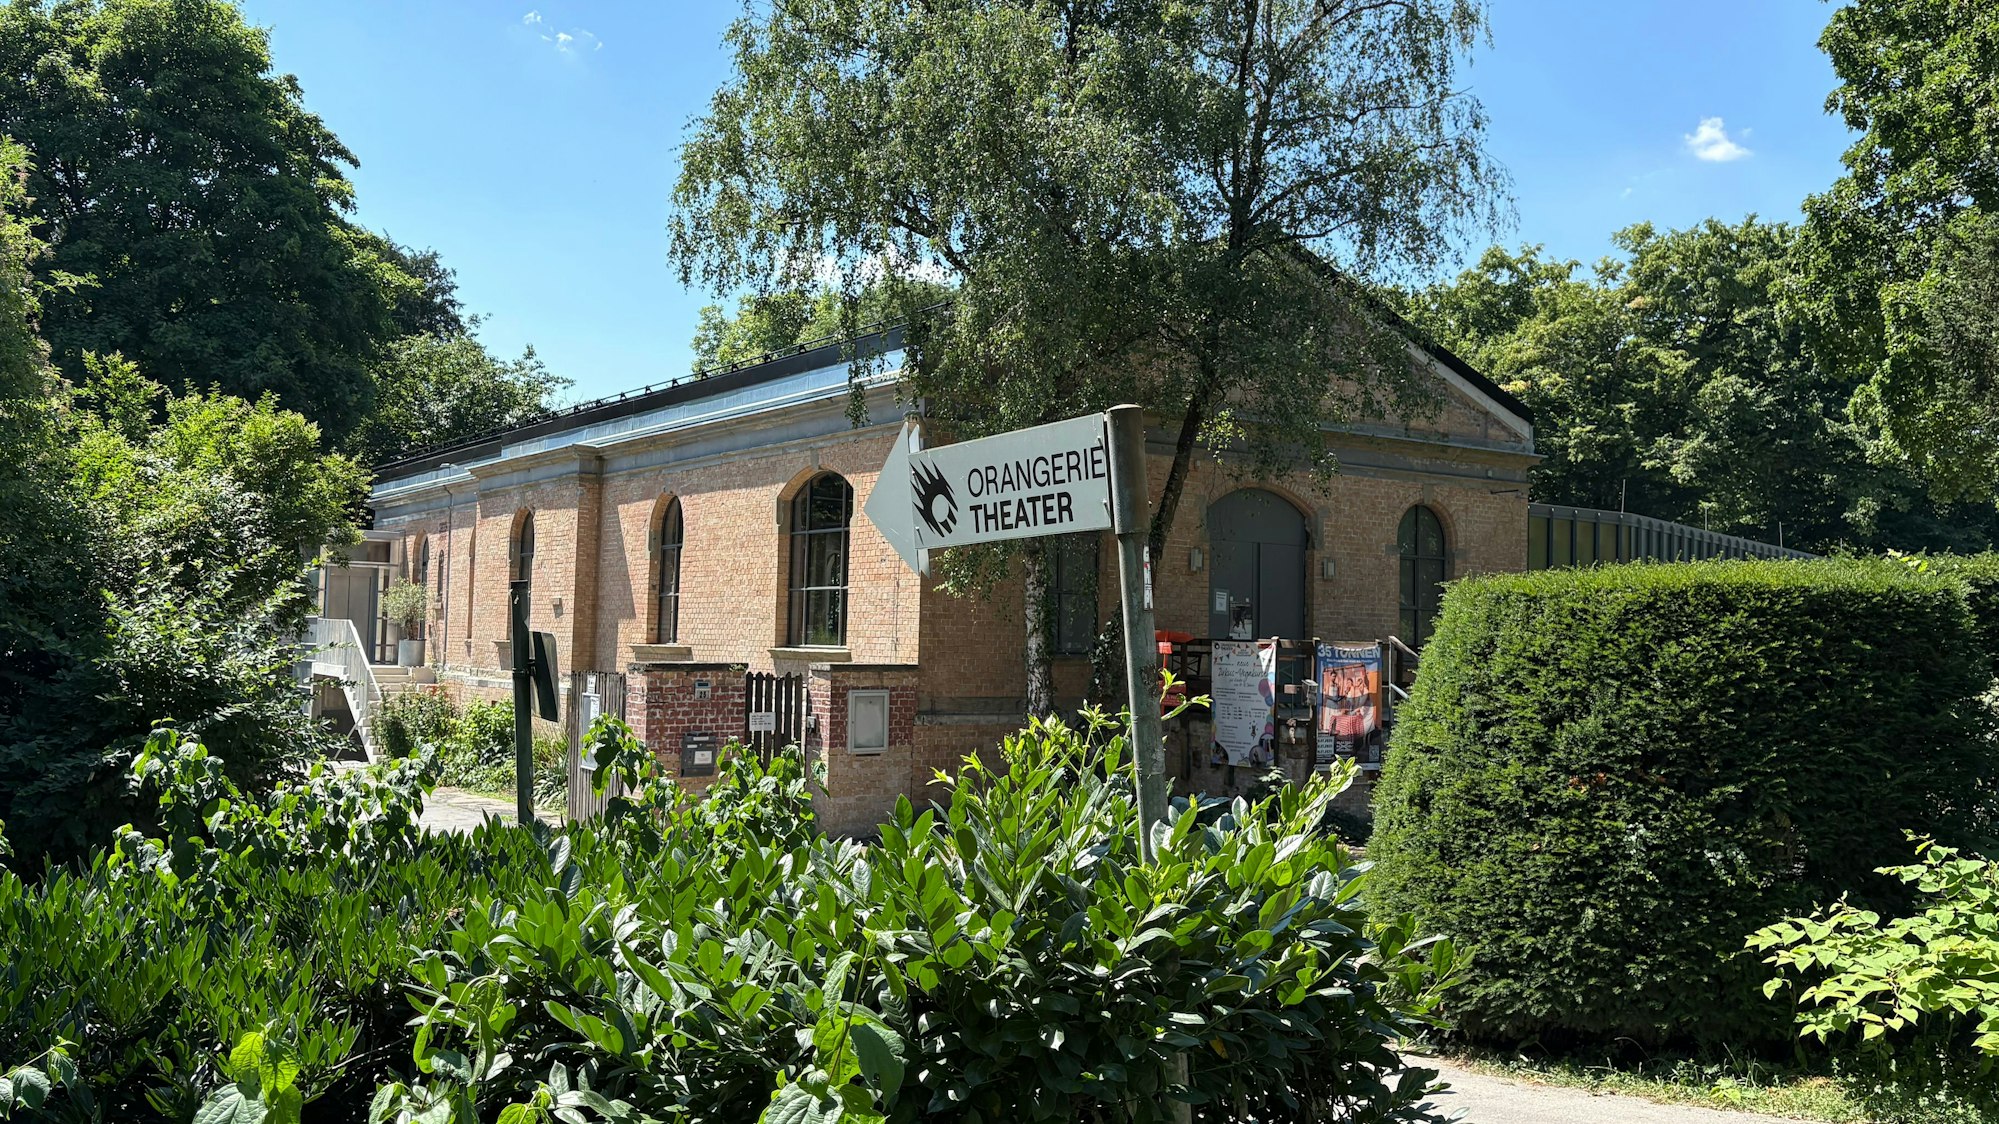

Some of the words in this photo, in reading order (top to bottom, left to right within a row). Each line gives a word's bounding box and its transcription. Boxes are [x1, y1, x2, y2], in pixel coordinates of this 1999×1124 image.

[967, 445, 1106, 498] ORANGERIE
[969, 491, 1074, 533] THEATER
[1317, 643, 1332, 657] 35
[1334, 646, 1381, 659] TONNEN
